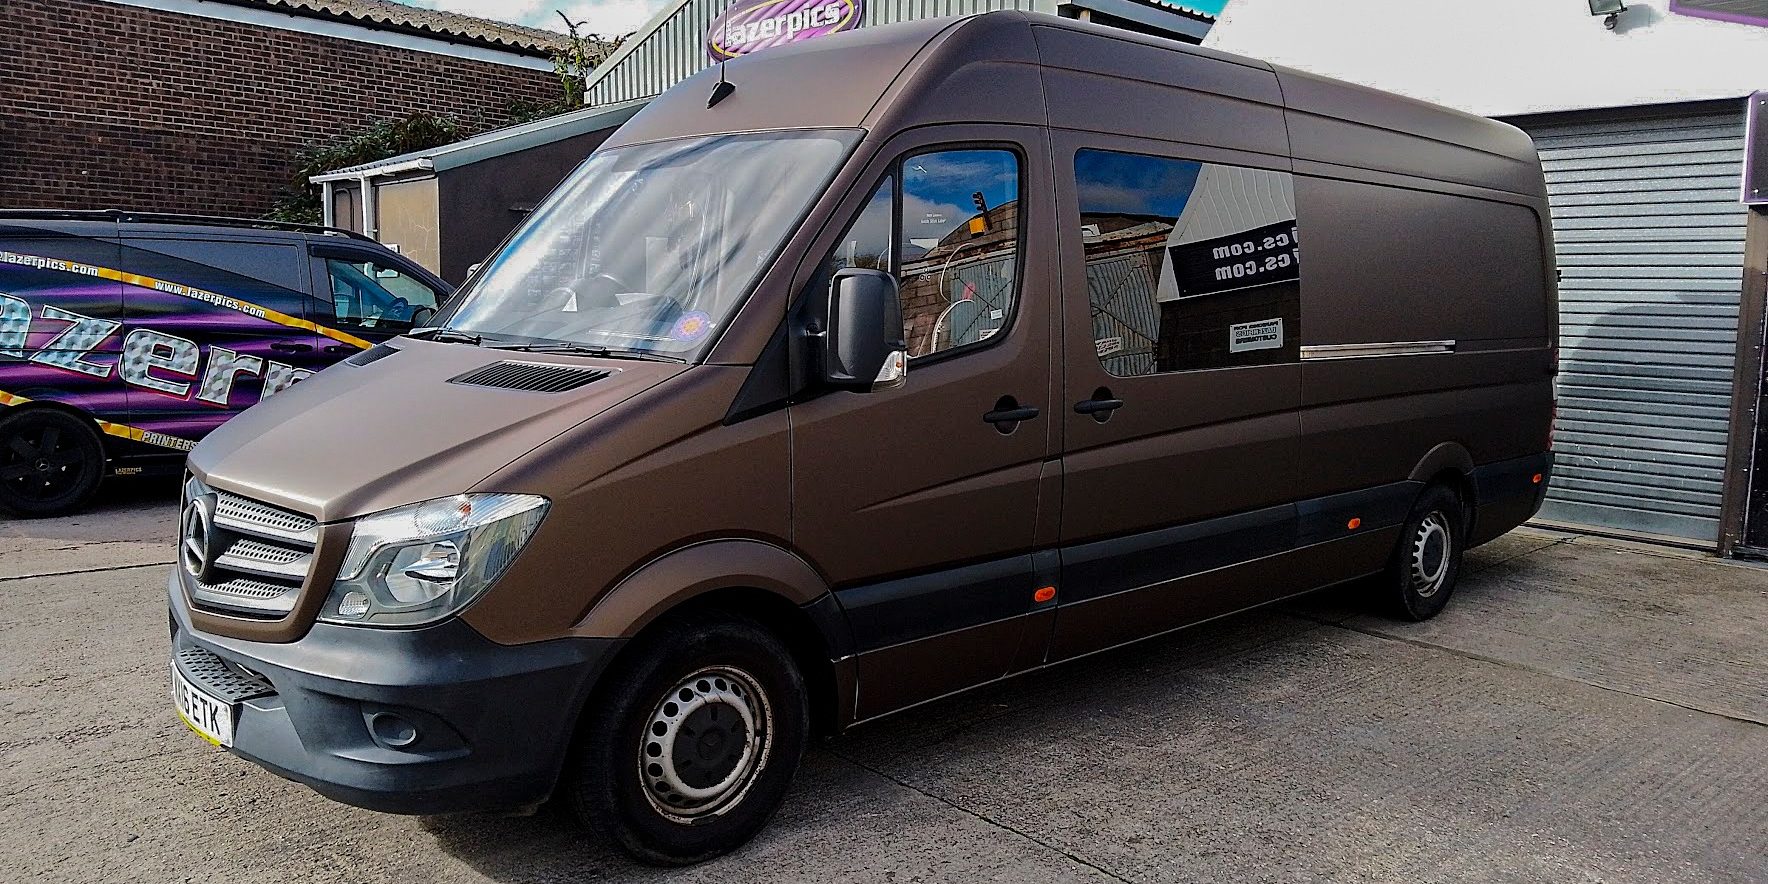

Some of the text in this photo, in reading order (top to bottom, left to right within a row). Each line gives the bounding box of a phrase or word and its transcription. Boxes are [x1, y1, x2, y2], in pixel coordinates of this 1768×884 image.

[724, 2, 841, 47] lazerpics
[155, 281, 265, 318] www.lazerpics.com
[191, 691, 220, 736] ETK
